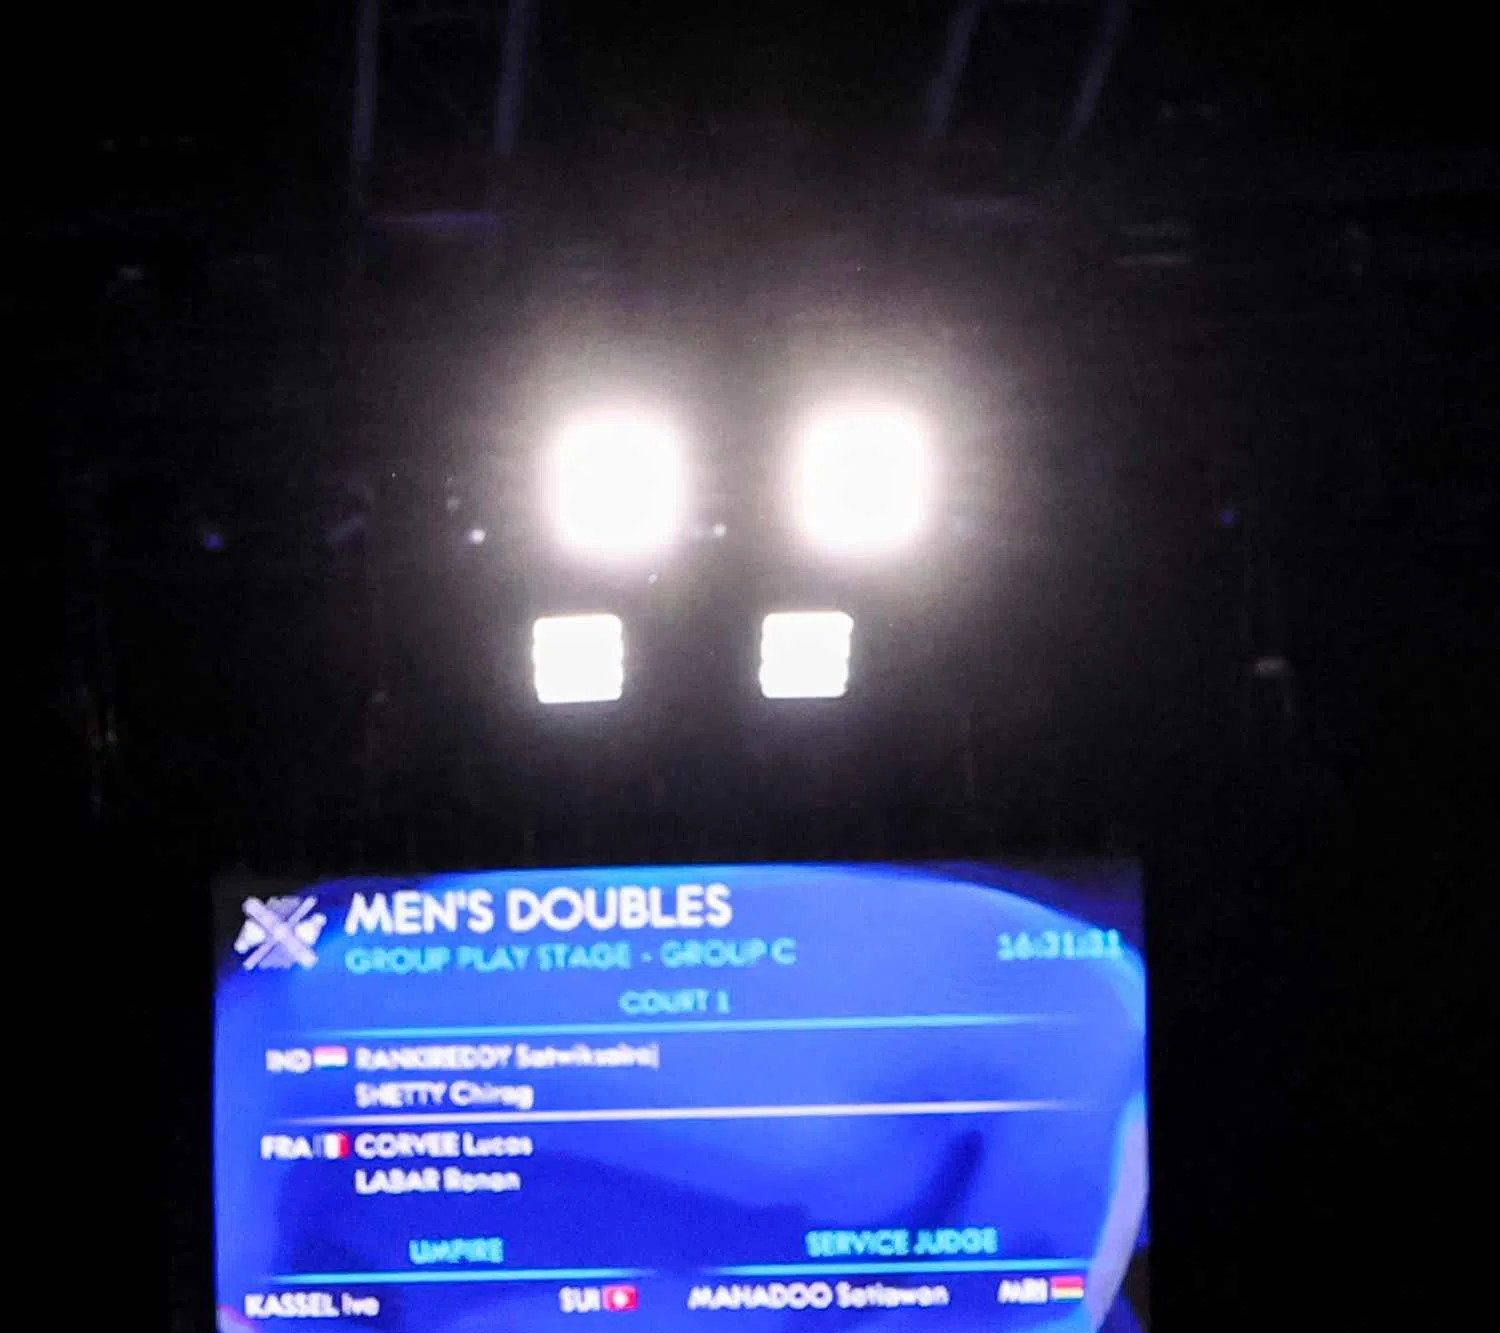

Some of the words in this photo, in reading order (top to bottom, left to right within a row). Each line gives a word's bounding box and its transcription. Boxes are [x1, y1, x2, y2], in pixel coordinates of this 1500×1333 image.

[344, 887, 493, 935] MEN'S
[507, 885, 732, 931] DOUBLES
[345, 946, 451, 973] GROUP
[458, 945, 532, 971] PLAY
[539, 942, 631, 969] STAGE
[661, 939, 766, 967] GROUP
[771, 938, 797, 965] C
[618, 990, 709, 1014] COURT
[718, 989, 729, 1012] 1
[354, 1082, 447, 1108] SHETTY
[450, 1081, 534, 1110] Chirag
[261, 1134, 313, 1160] FRA
[354, 1131, 461, 1159] CORVEE
[463, 1132, 534, 1158] Lucas
[354, 1168, 441, 1194] LABAR
[443, 1167, 522, 1193] Ronan
[409, 1237, 504, 1264] UMPIRE
[806, 1228, 909, 1257] SERVICE
[914, 1227, 998, 1254] JUDGE
[559, 1286, 600, 1313] SUI
[688, 1282, 833, 1310] MAHADOO
[997, 1279, 1048, 1304] MRI
[244, 1293, 339, 1319] KASSEL
[342, 1292, 380, 1317] Ivo
